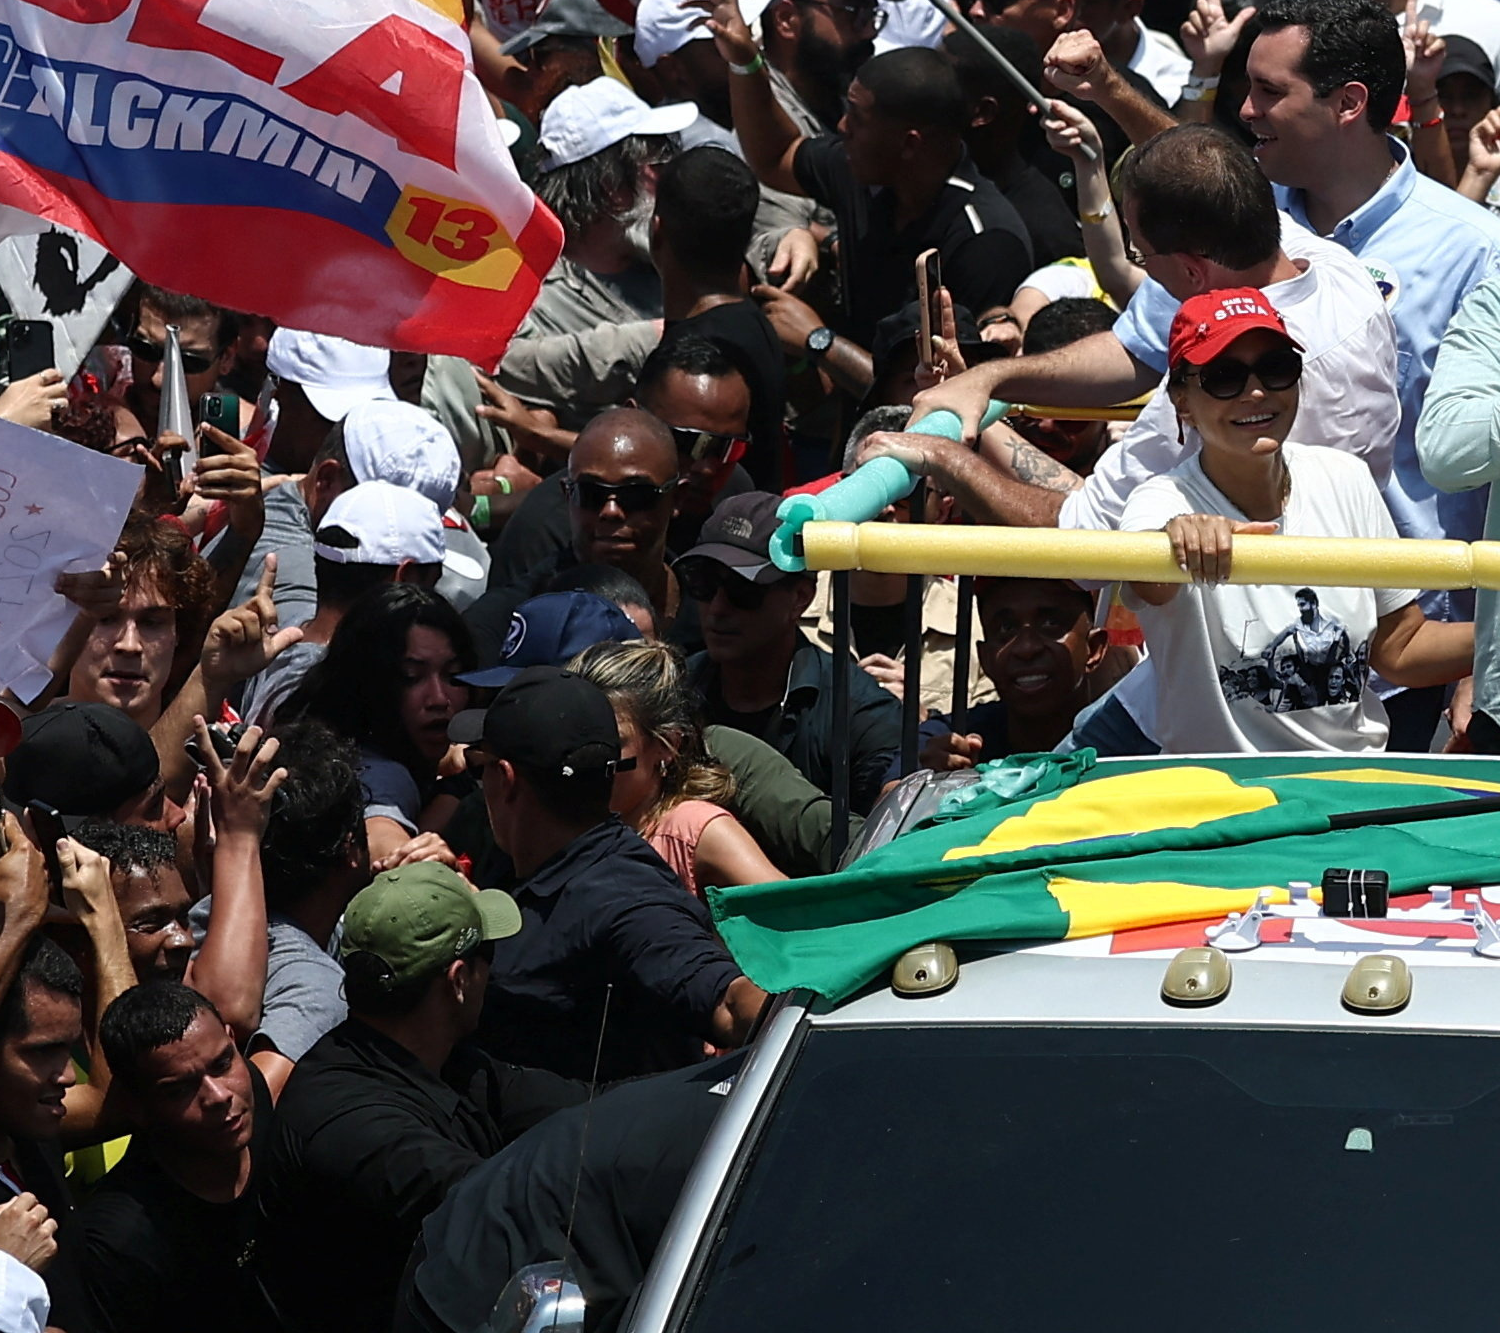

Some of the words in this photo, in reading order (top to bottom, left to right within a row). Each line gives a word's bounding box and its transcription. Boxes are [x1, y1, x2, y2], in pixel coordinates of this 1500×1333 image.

[25, 61, 380, 205] ALCKMIN
[404, 192, 502, 263] 13
[1213, 303, 1270, 321] SILVA
